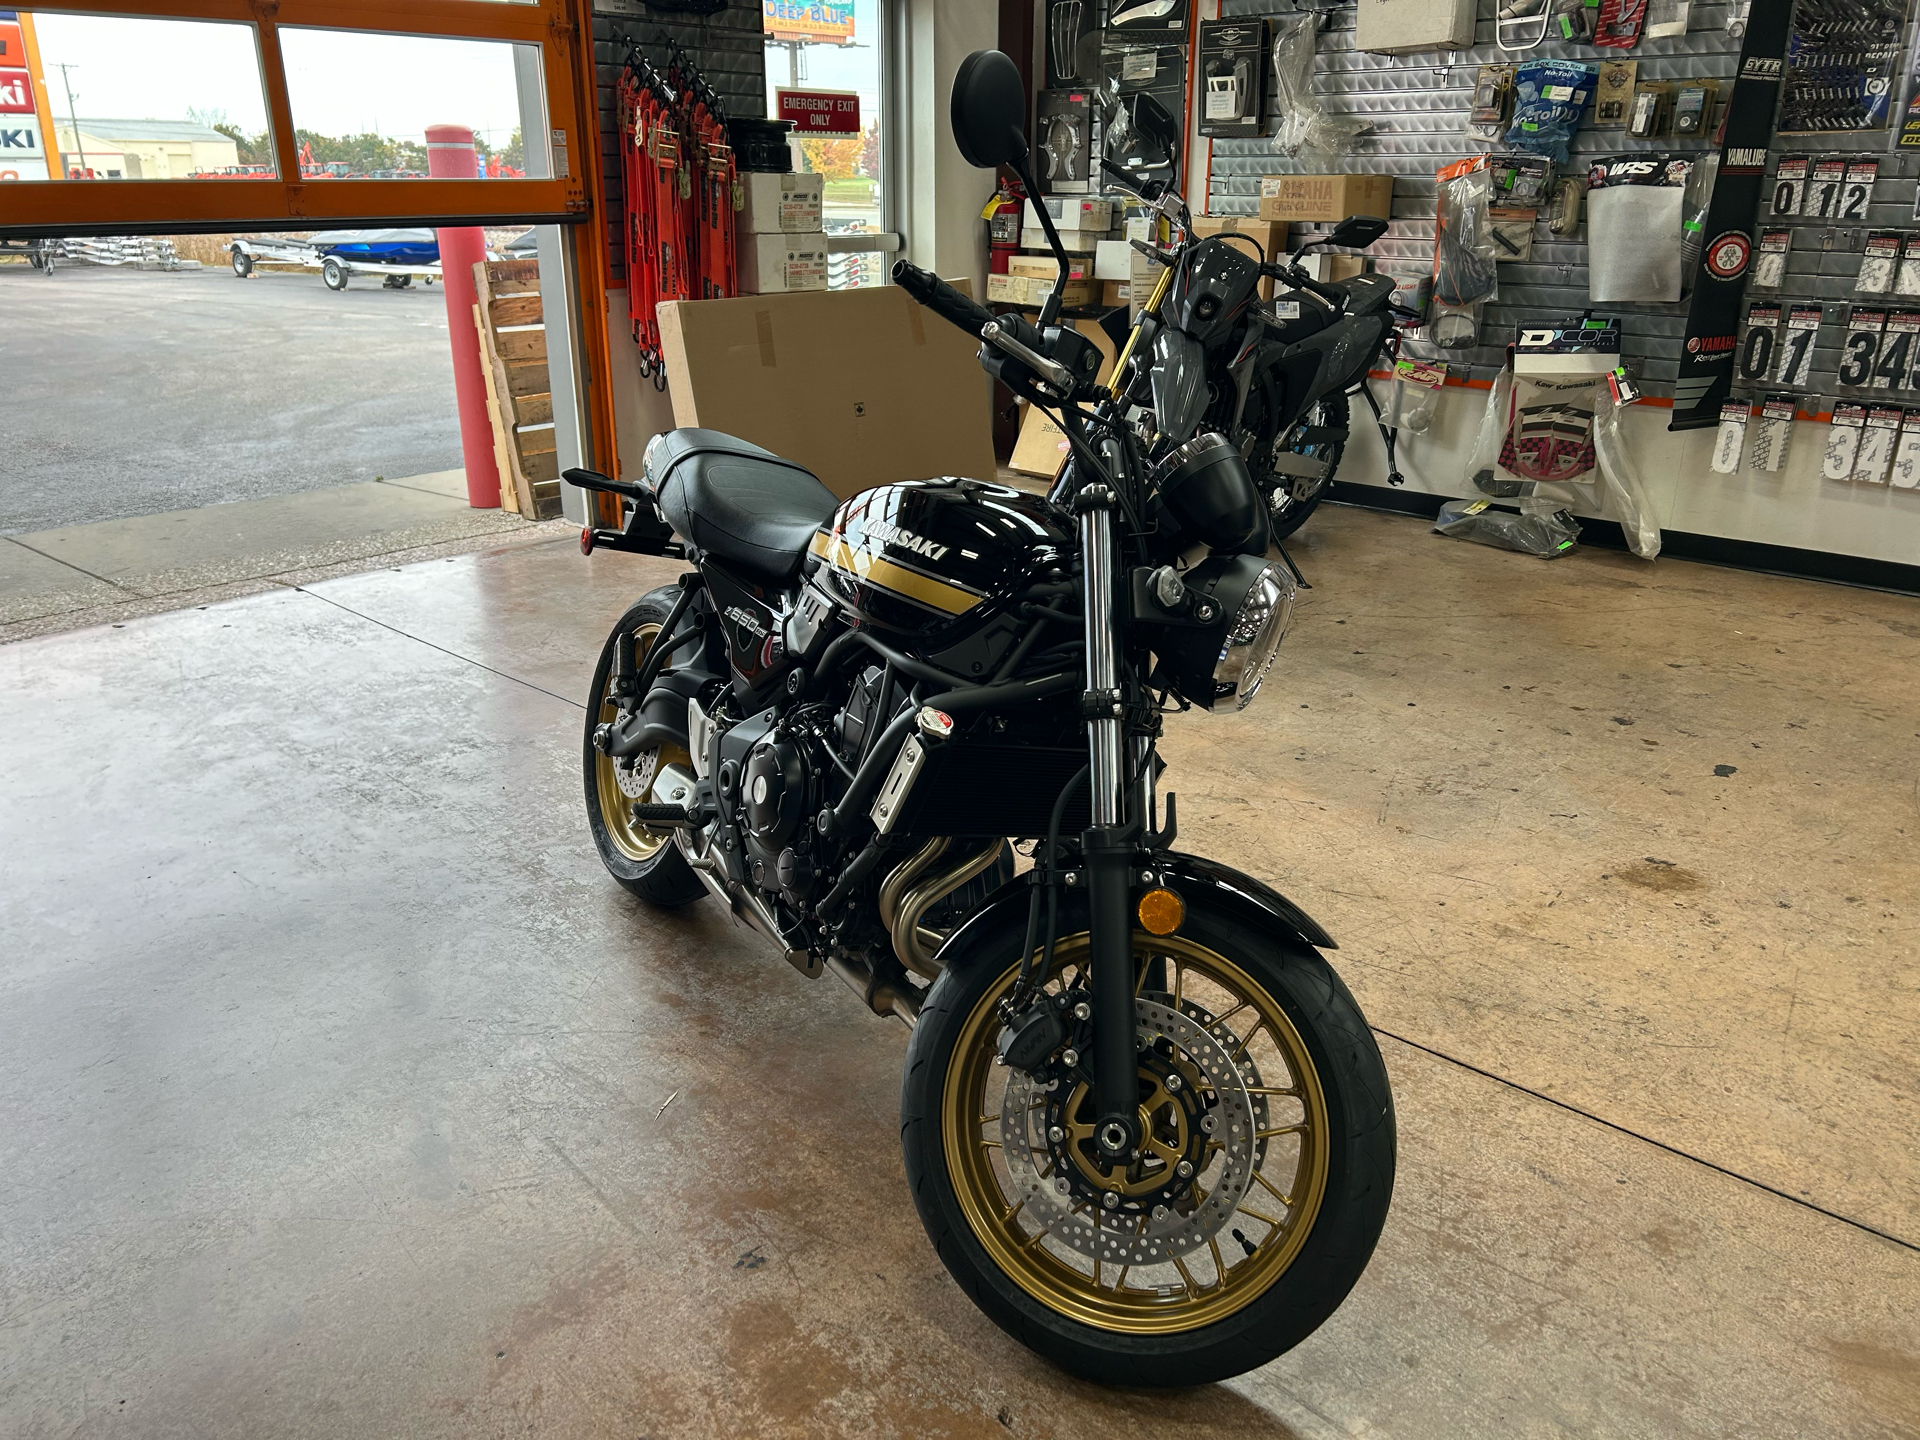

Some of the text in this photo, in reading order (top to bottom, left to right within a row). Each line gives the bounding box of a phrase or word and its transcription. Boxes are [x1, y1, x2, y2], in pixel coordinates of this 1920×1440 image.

[766, 0, 848, 24] DEEP BLUE
[1522, 62, 1534, 70] AIR
[1552, 61, 1582, 70] COVER
[1743, 57, 1782, 72] GYTR
[783, 97, 855, 112] EMERGENCY EXIT
[810, 113, 831, 126] ONLY
[0, 129, 35, 149] KI
[1819, 183, 1837, 216] 1
[1844, 185, 1866, 218] 2
[1782, 330, 1814, 384] 1
[1839, 331, 1877, 386] 3
[1874, 332, 1912, 390] 4
[1555, 380, 1596, 391] Kawasaki
[857, 517, 950, 561] KAWASAKI
